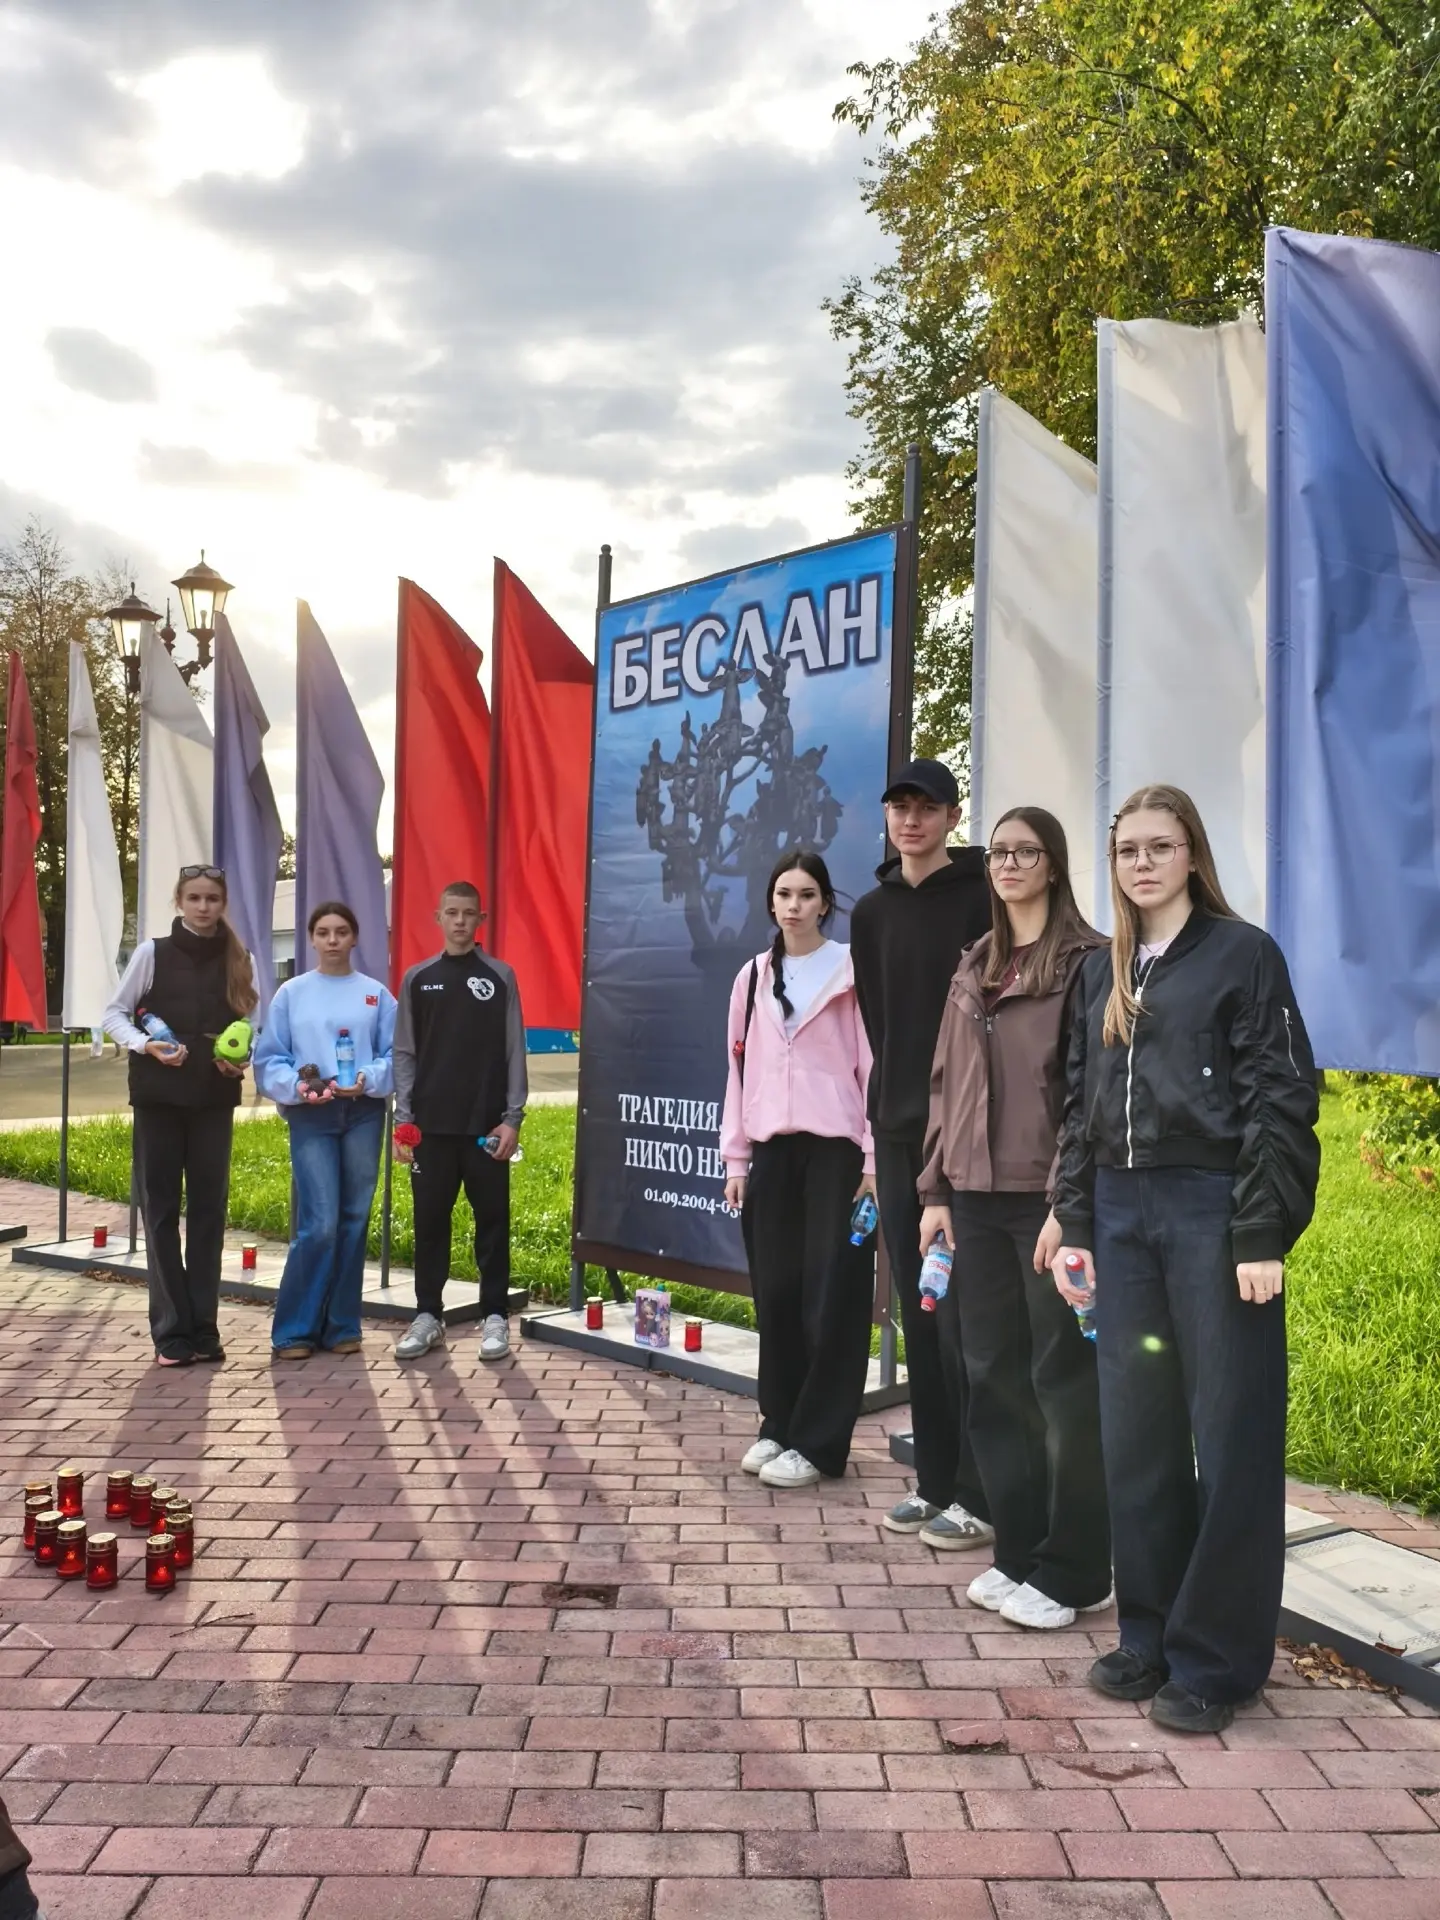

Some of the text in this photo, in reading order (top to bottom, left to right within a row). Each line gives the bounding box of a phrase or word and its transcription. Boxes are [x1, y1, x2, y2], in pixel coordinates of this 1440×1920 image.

[612, 577, 879, 710] БЕСЛАН
[624, 1137, 726, 1179] НИКТО НЕ
